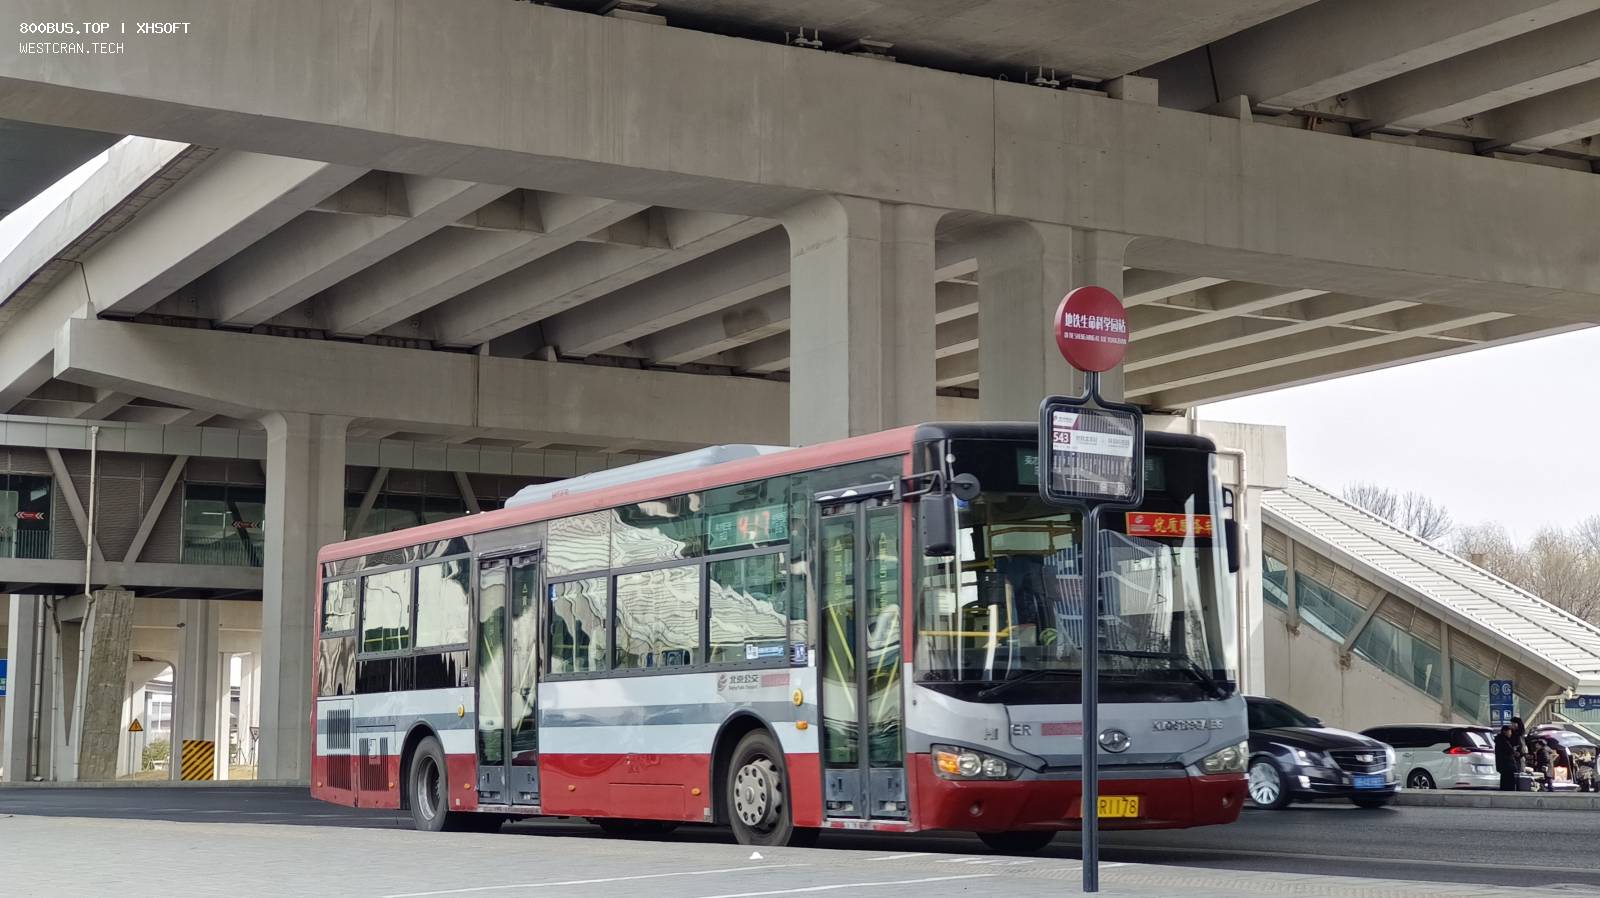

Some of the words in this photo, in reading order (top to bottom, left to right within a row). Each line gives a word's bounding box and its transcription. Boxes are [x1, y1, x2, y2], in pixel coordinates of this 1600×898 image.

[1065, 312, 1126, 333] 地铁生命科学园站
[1053, 431, 1069, 443] 543
[1098, 799, 1137, 815] R1178
